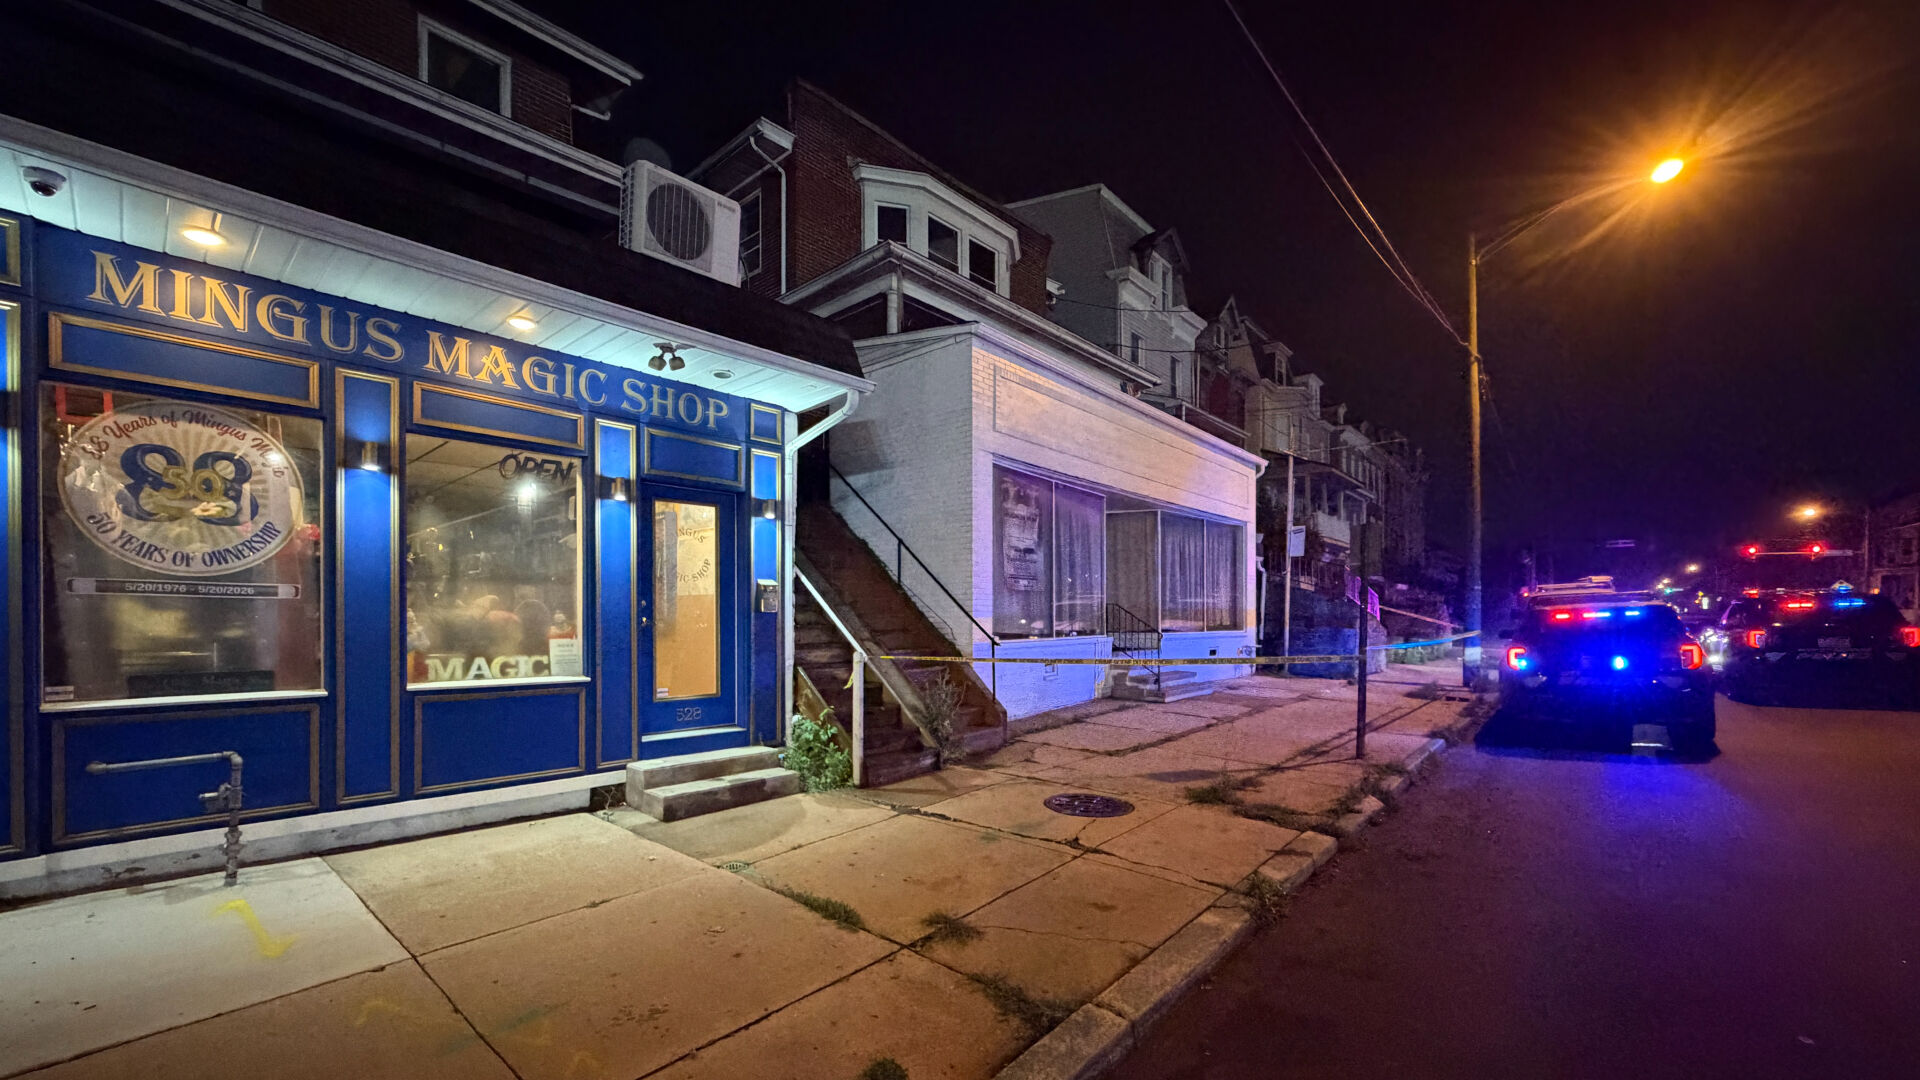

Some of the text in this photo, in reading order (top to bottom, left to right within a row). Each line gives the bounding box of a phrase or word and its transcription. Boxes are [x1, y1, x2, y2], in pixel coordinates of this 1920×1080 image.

[86, 250, 729, 430] MINGUS MAGIC SHOP
[103, 414, 157, 439] Years
[161, 413, 178, 428] of
[182, 409, 248, 441] Mingus
[250, 437, 289, 478] Mic
[115, 443, 260, 526] 88
[162, 465, 225, 501] 50
[499, 453, 576, 486] OPEN
[86, 513, 282, 568] 50 YEARS OF OWNERSHIP
[678, 527, 705, 544] NGUS
[692, 558, 711, 582] SHOP
[125, 582, 187, 593] 5/20/1976
[198, 584, 255, 595] 5/20/2026
[425, 654, 549, 681] MAGIC
[676, 706, 702, 722] 528
